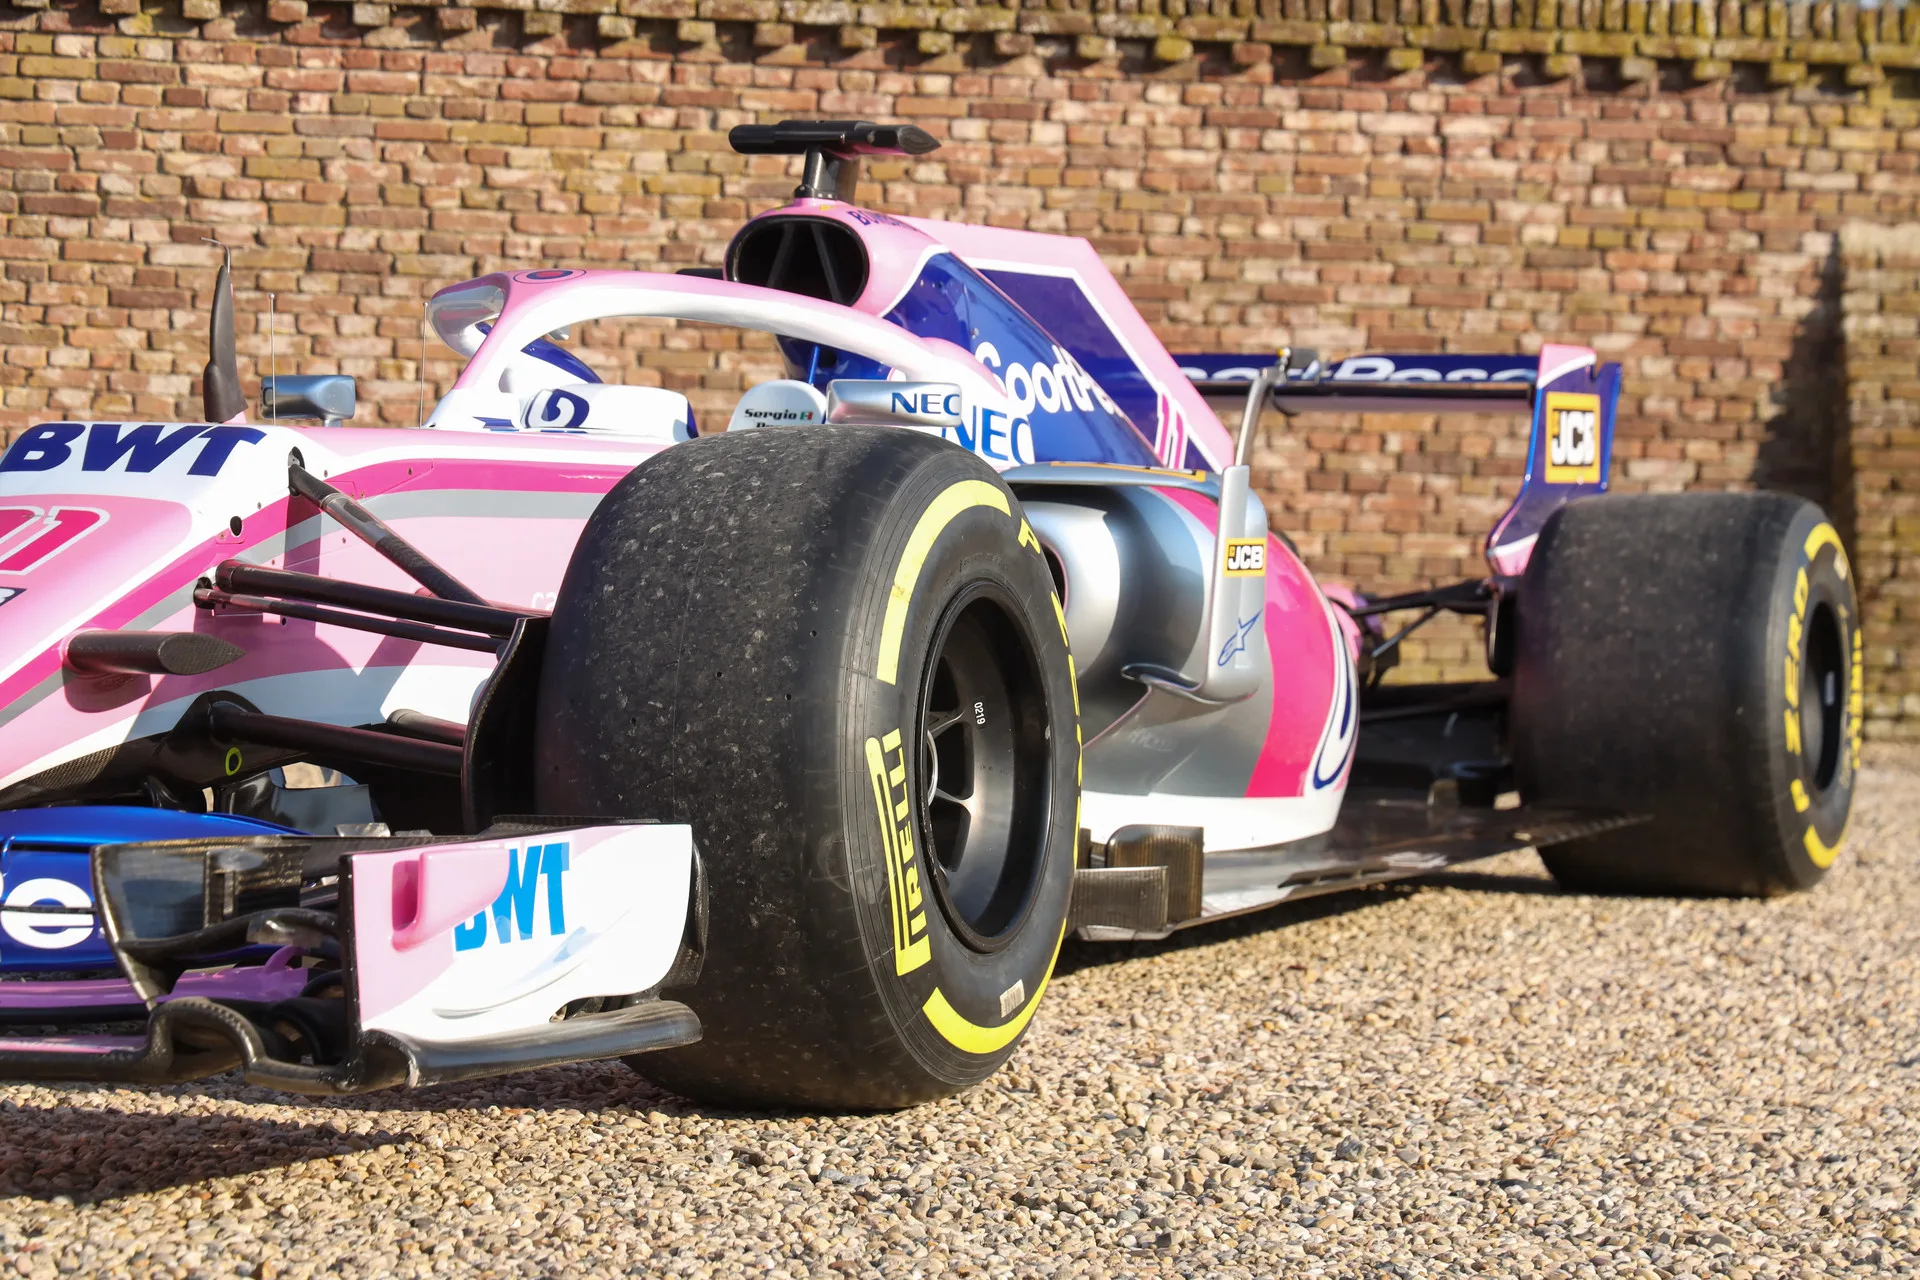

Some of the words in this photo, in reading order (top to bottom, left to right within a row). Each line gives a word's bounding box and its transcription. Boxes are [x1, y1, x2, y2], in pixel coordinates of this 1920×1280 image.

[745, 408, 797, 420] Sergio
[892, 392, 960, 414] NEC
[1, 423, 267, 476] BWT
[1551, 410, 1595, 465] JCB
[1228, 545, 1263, 570] JCB
[974, 701, 986, 725] 0219
[865, 728, 932, 977] PIRELLI
